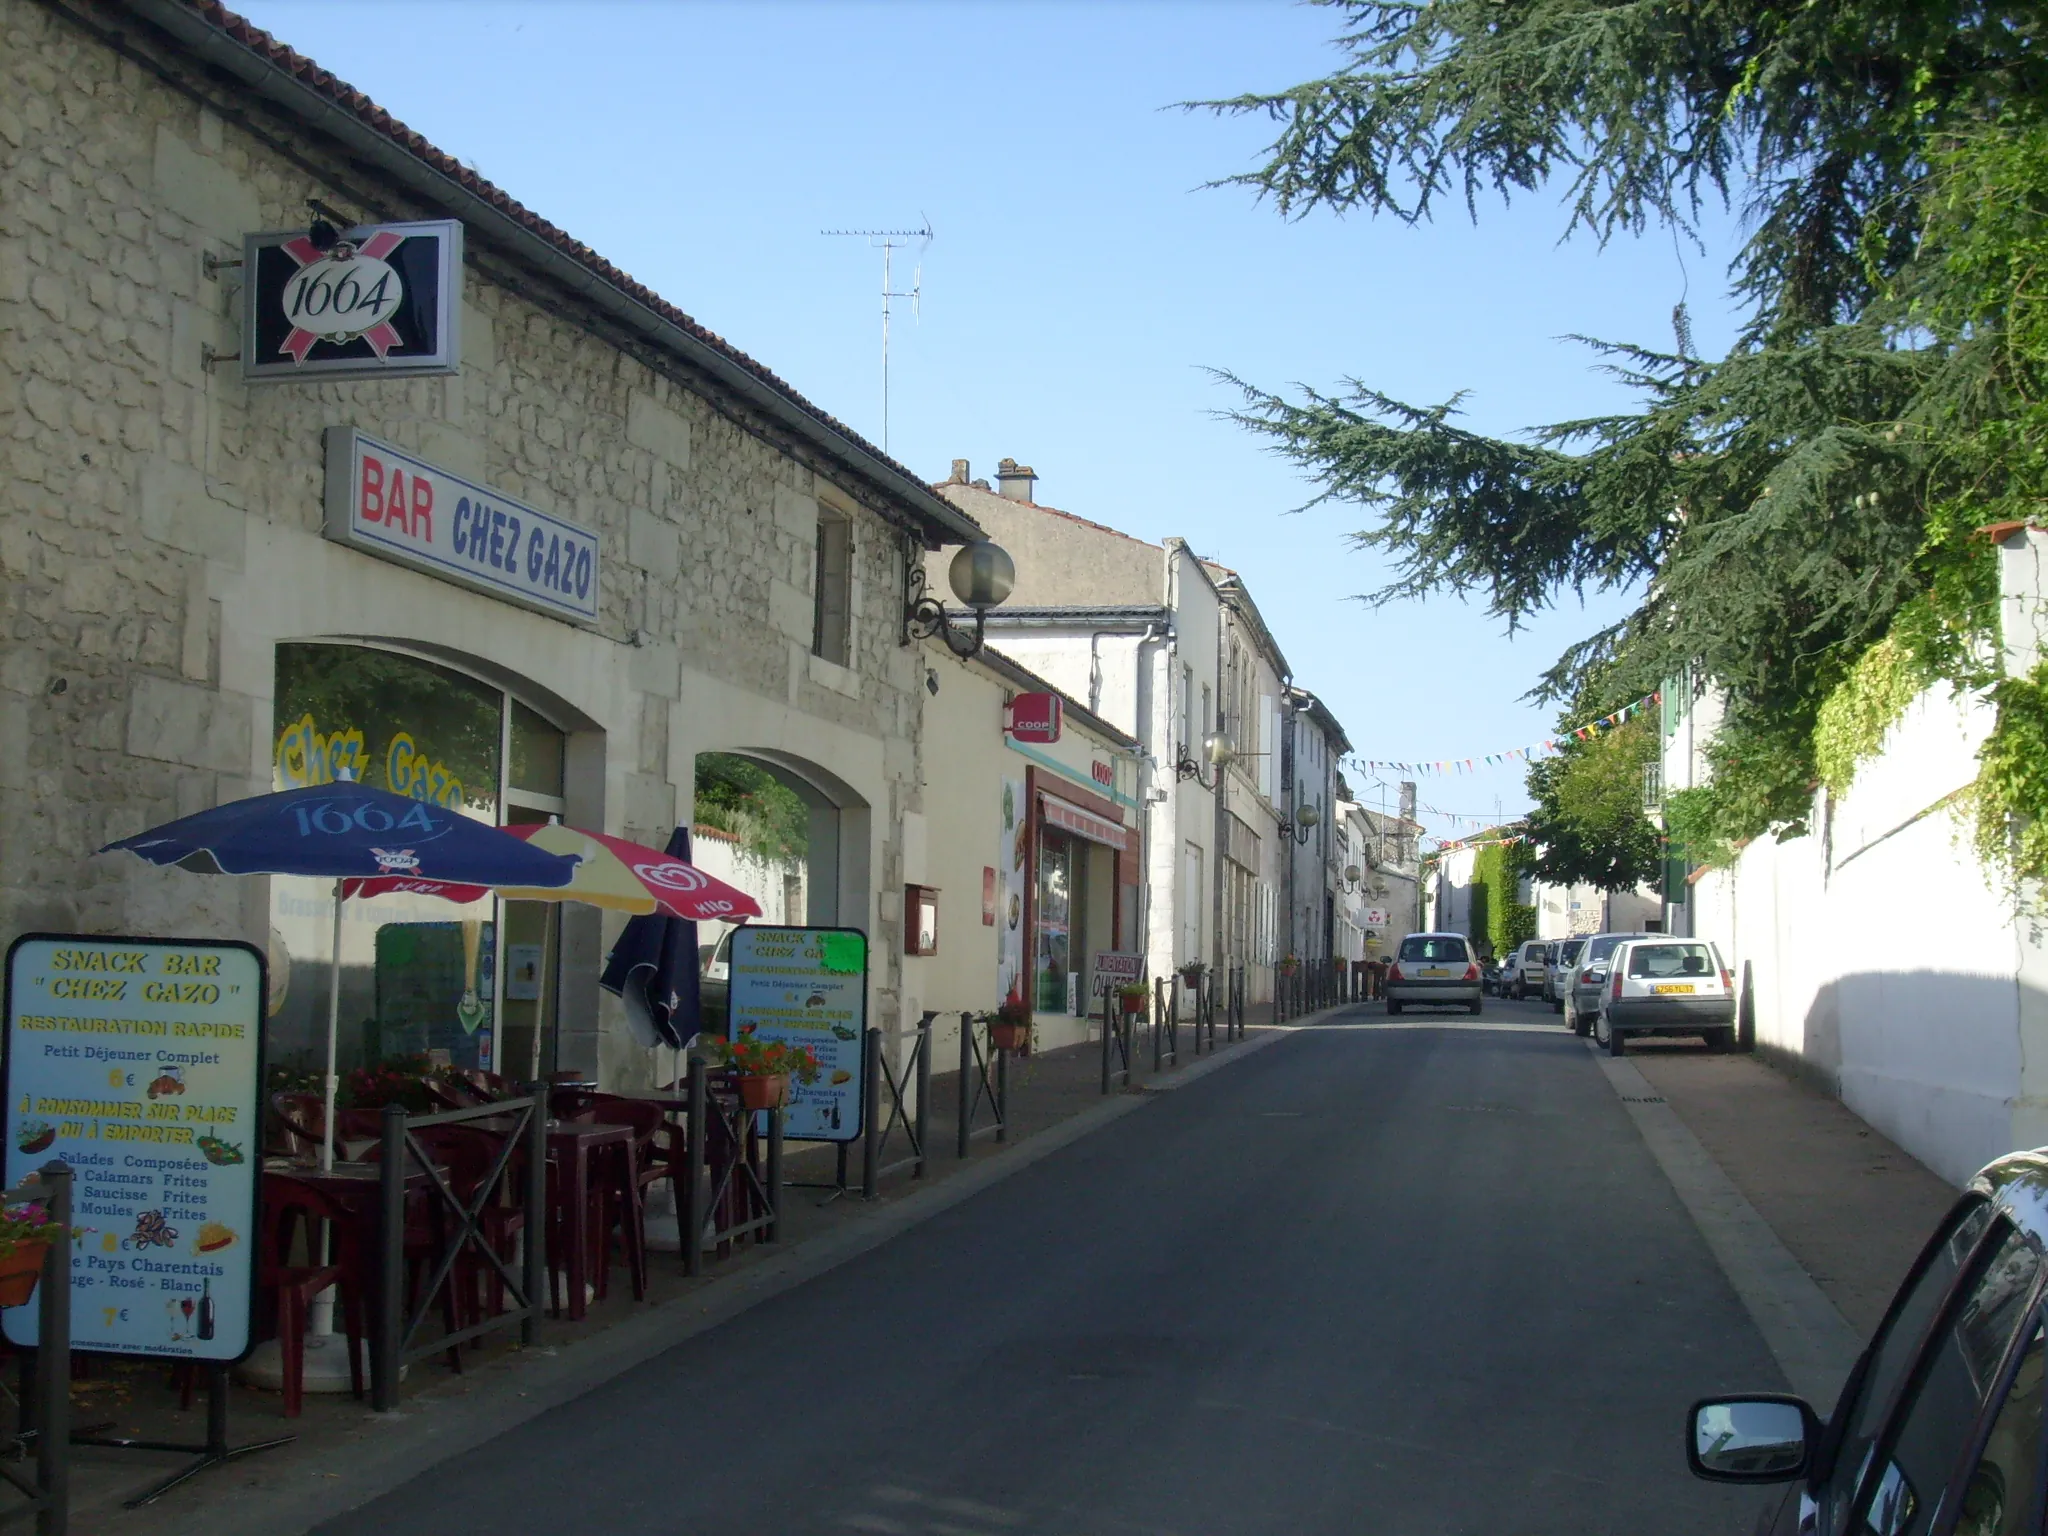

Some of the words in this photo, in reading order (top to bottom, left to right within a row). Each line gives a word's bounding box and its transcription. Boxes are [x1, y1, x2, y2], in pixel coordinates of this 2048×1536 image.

[291, 267, 395, 317] 1664
[360, 455, 434, 544] BAR
[452, 496, 523, 574] CHEZ
[526, 526, 592, 601] GAZO
[1017, 720, 1049, 730] COOP
[277, 713, 370, 788] Chez
[295, 801, 445, 837] 1664
[755, 931, 806, 944] SNACK
[52, 949, 149, 974] SNACK
[164, 953, 222, 977] BAR
[51, 977, 128, 1001] CHEZ
[141, 981, 221, 1005] GAZO
[18, 1014, 167, 1036] RESTAURATION
[171, 1021, 245, 1040] RAPIDE
[44, 1044, 79, 1059] Petit
[84, 1045, 152, 1062] Déjeuner
[156, 1049, 220, 1066] Complet
[19, 1095, 32, 1114] À
[36, 1098, 142, 1120] CONSOMMER
[147, 1102, 181, 1121] SUR
[186, 1105, 239, 1125] PLACE
[57, 1120, 84, 1138] OU
[87, 1119, 100, 1140] À
[105, 1123, 195, 1145] EMPORTER
[58, 1151, 115, 1167] Salades
[124, 1155, 209, 1172] Composées
[84, 1170, 154, 1186] Calamars
[163, 1174, 208, 1189] Frites
[84, 1186, 149, 1202] Saucisse
[162, 1190, 208, 1206] Frites
[80, 1202, 133, 1217] Moules
[162, 1206, 207, 1222] Frites
[87, 1255, 127, 1273] Pays
[131, 1258, 225, 1277] Charentais
[109, 1276, 146, 1290] Rosé
[160, 1279, 203, 1293] Blanc
